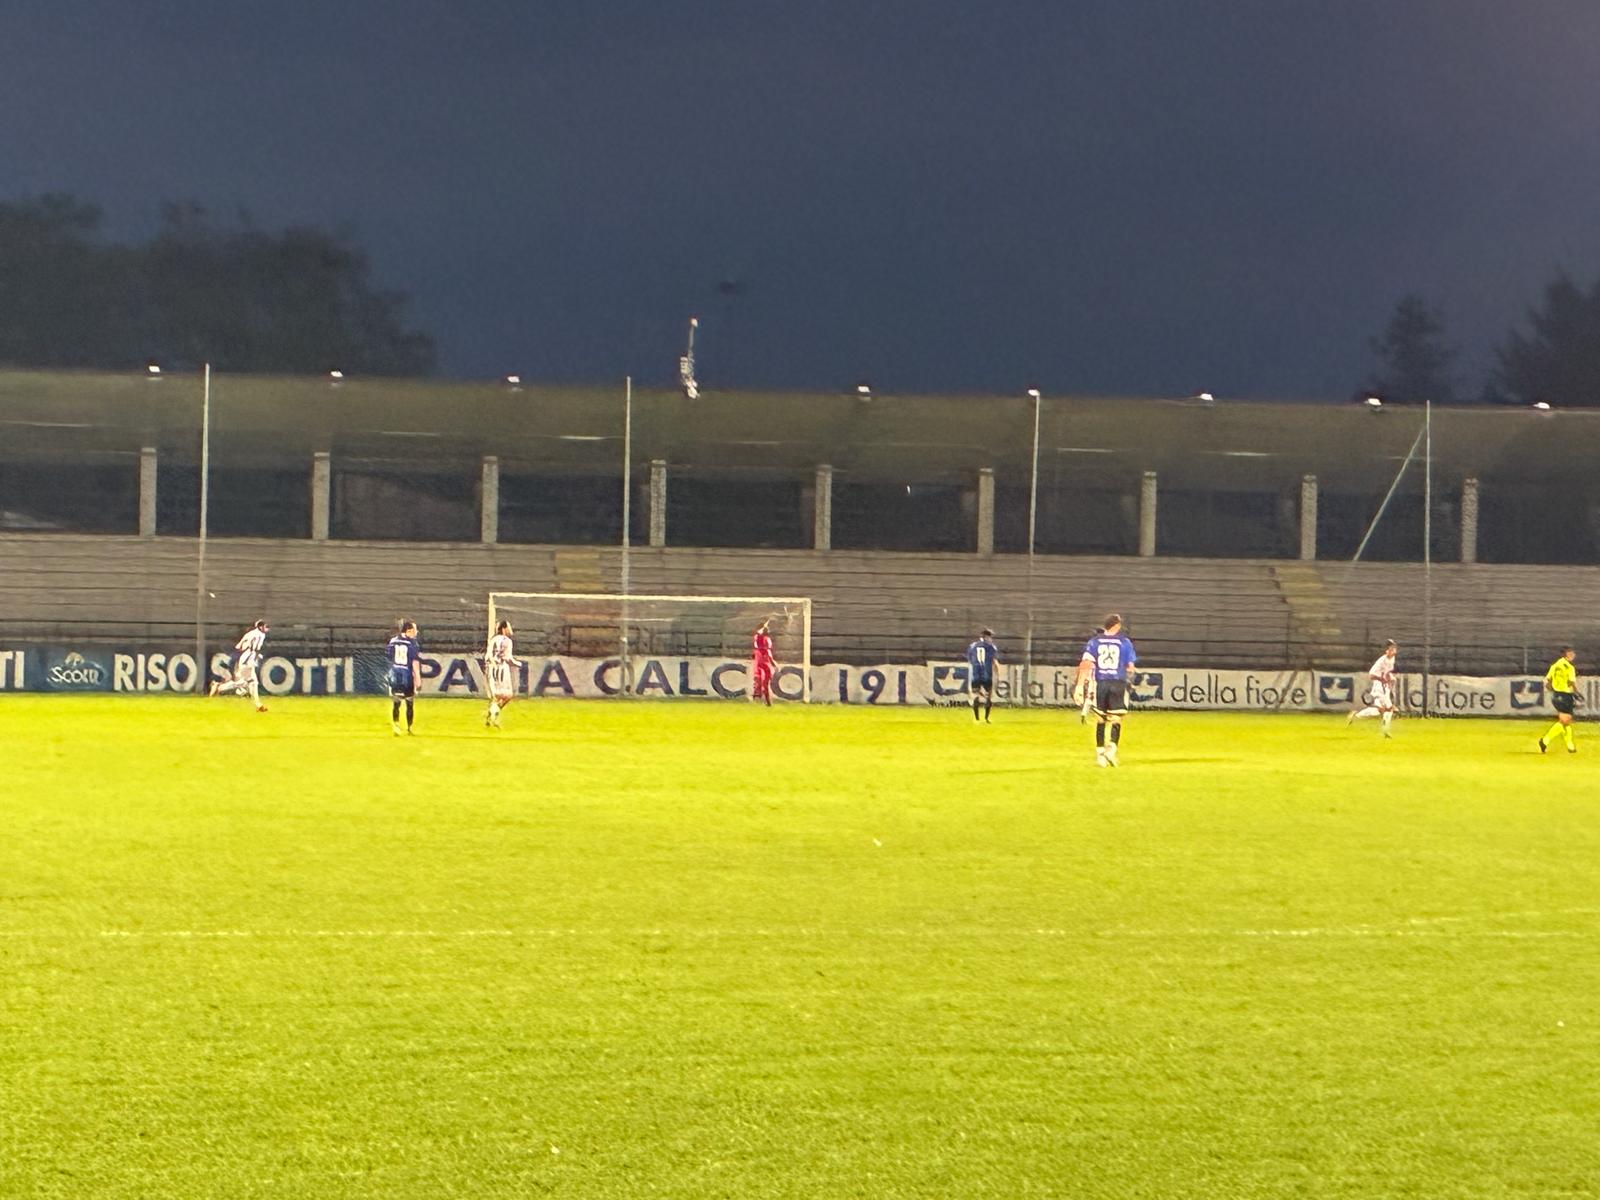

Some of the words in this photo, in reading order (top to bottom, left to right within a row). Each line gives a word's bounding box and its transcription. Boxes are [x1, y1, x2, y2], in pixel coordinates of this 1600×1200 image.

[114, 653, 198, 692] RISO
[211, 653, 354, 695] SOTTI
[593, 658, 812, 701] CALCO
[1170, 673, 1237, 705] della
[1436, 679, 1496, 710] fiore
